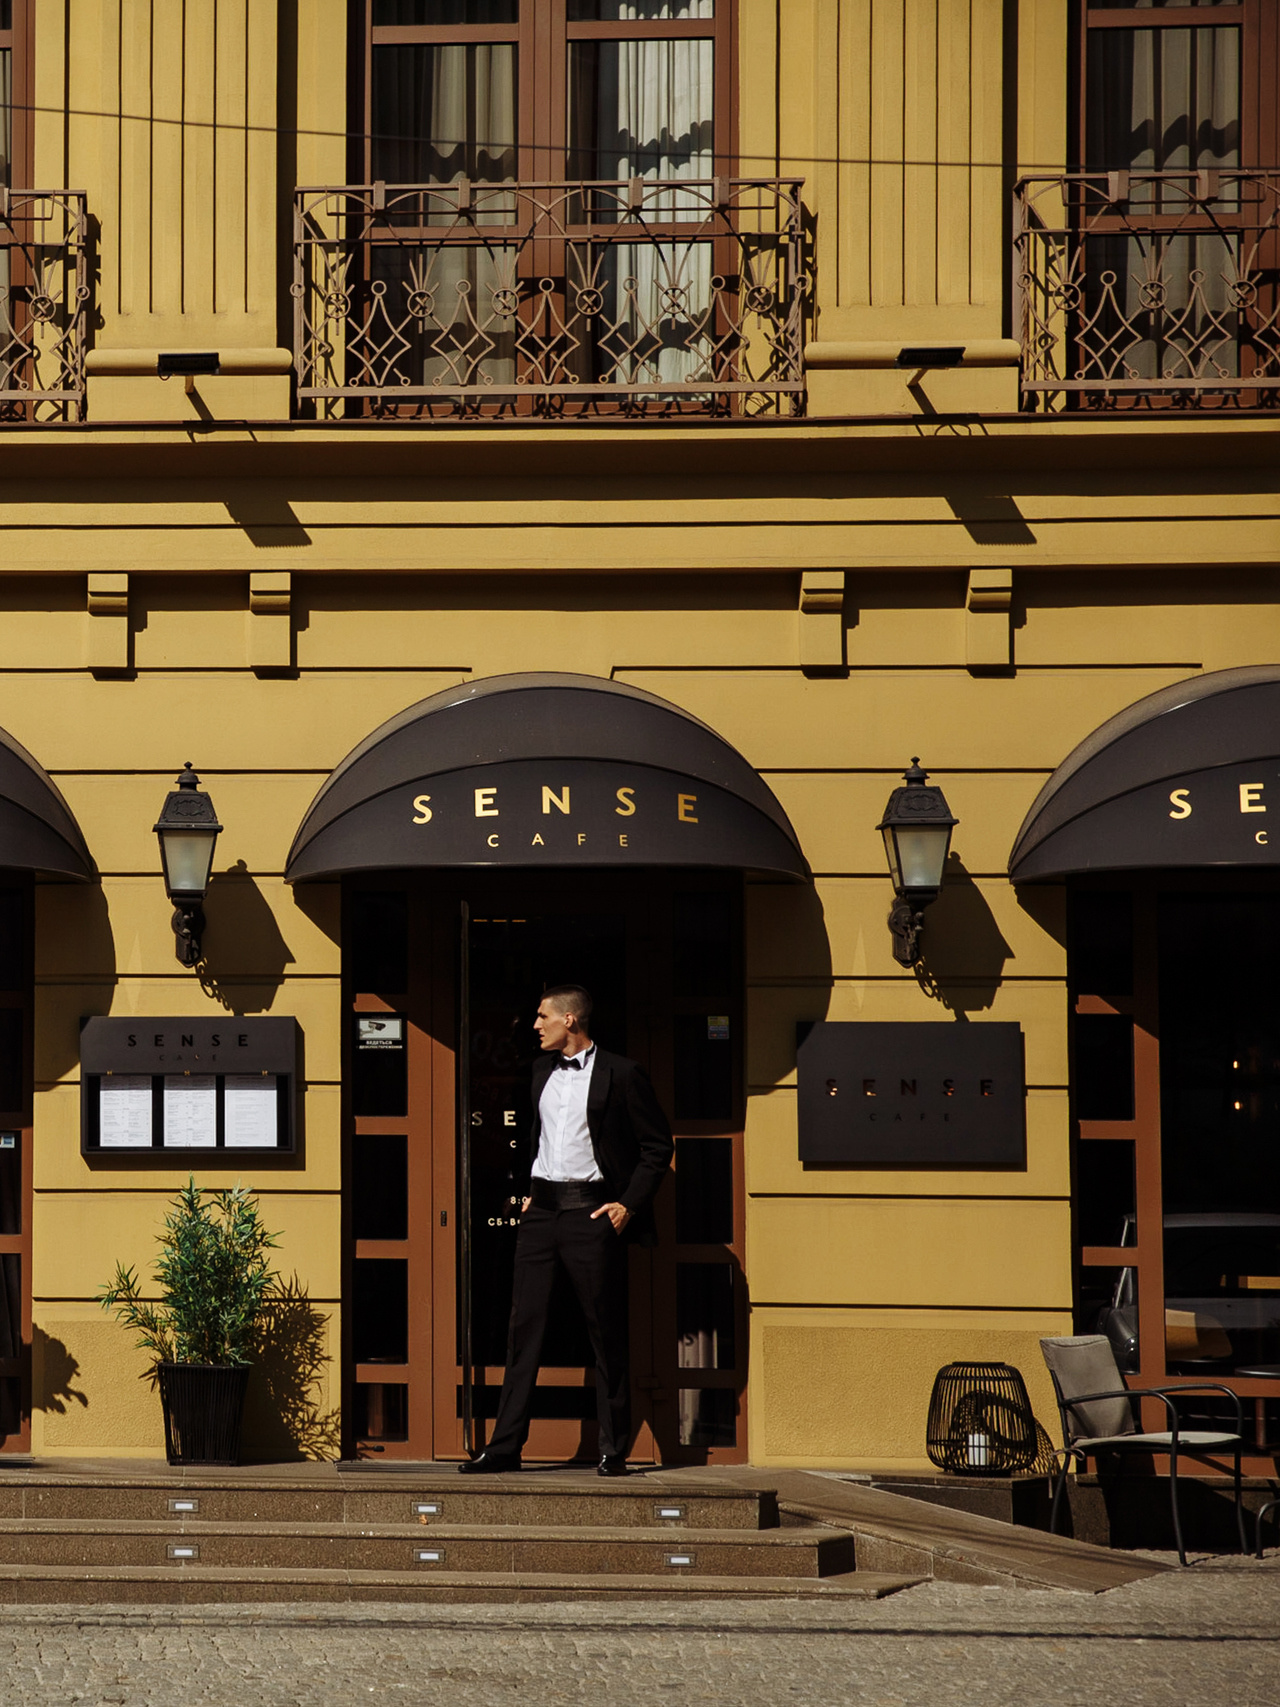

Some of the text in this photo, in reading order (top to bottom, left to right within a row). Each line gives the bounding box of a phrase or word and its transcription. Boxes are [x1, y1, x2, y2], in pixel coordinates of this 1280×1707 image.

[412, 786, 699, 824] SENSE
[487, 833, 629, 848] CAFE
[127, 1034, 249, 1047] SENSE
[825, 1079, 995, 1097] SENSE
